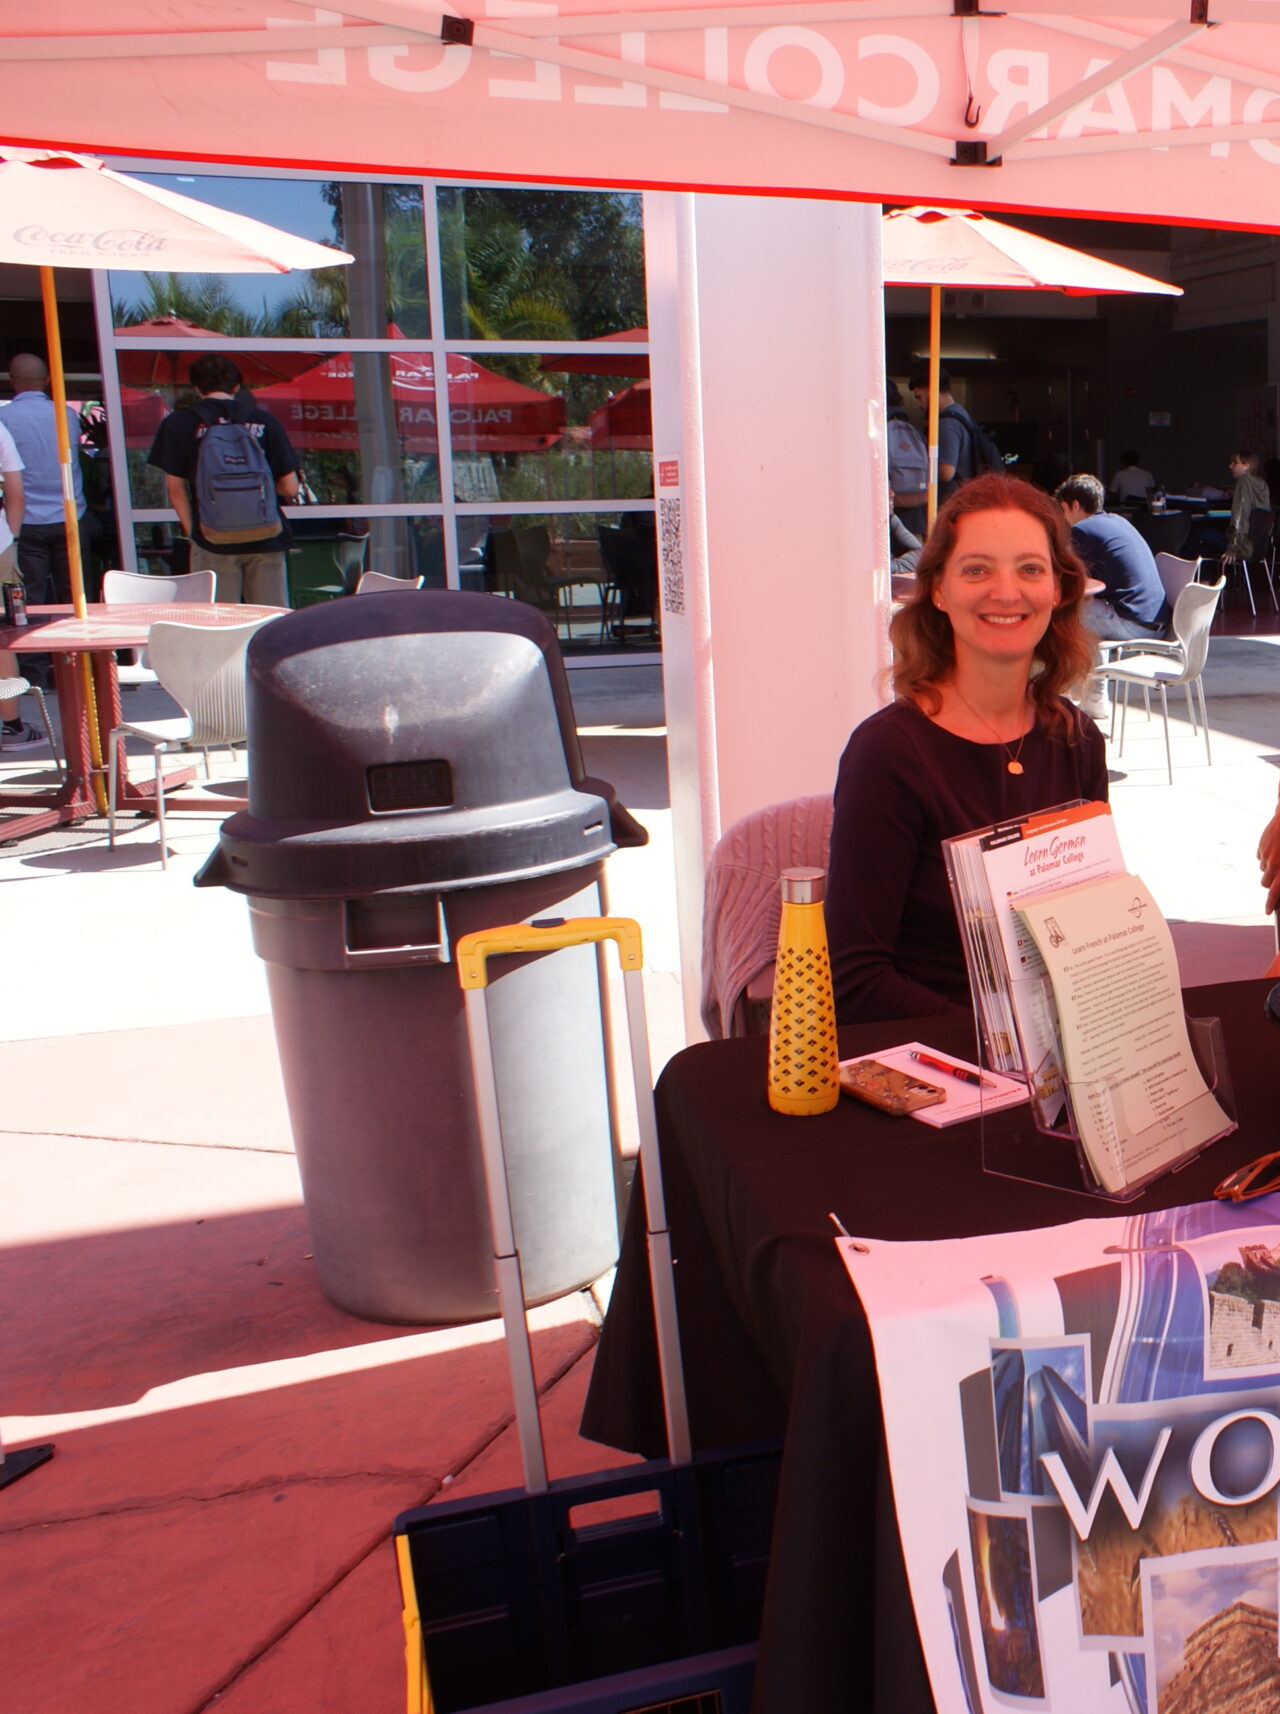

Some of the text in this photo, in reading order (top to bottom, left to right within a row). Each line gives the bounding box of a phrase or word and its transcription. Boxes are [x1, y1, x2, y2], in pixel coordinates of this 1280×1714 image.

[1024, 836, 1086, 867] Learn German
[1030, 852, 1085, 877] at Palomar College
[1072, 944, 1086, 955] Learn
[1086, 937, 1102, 950] French
